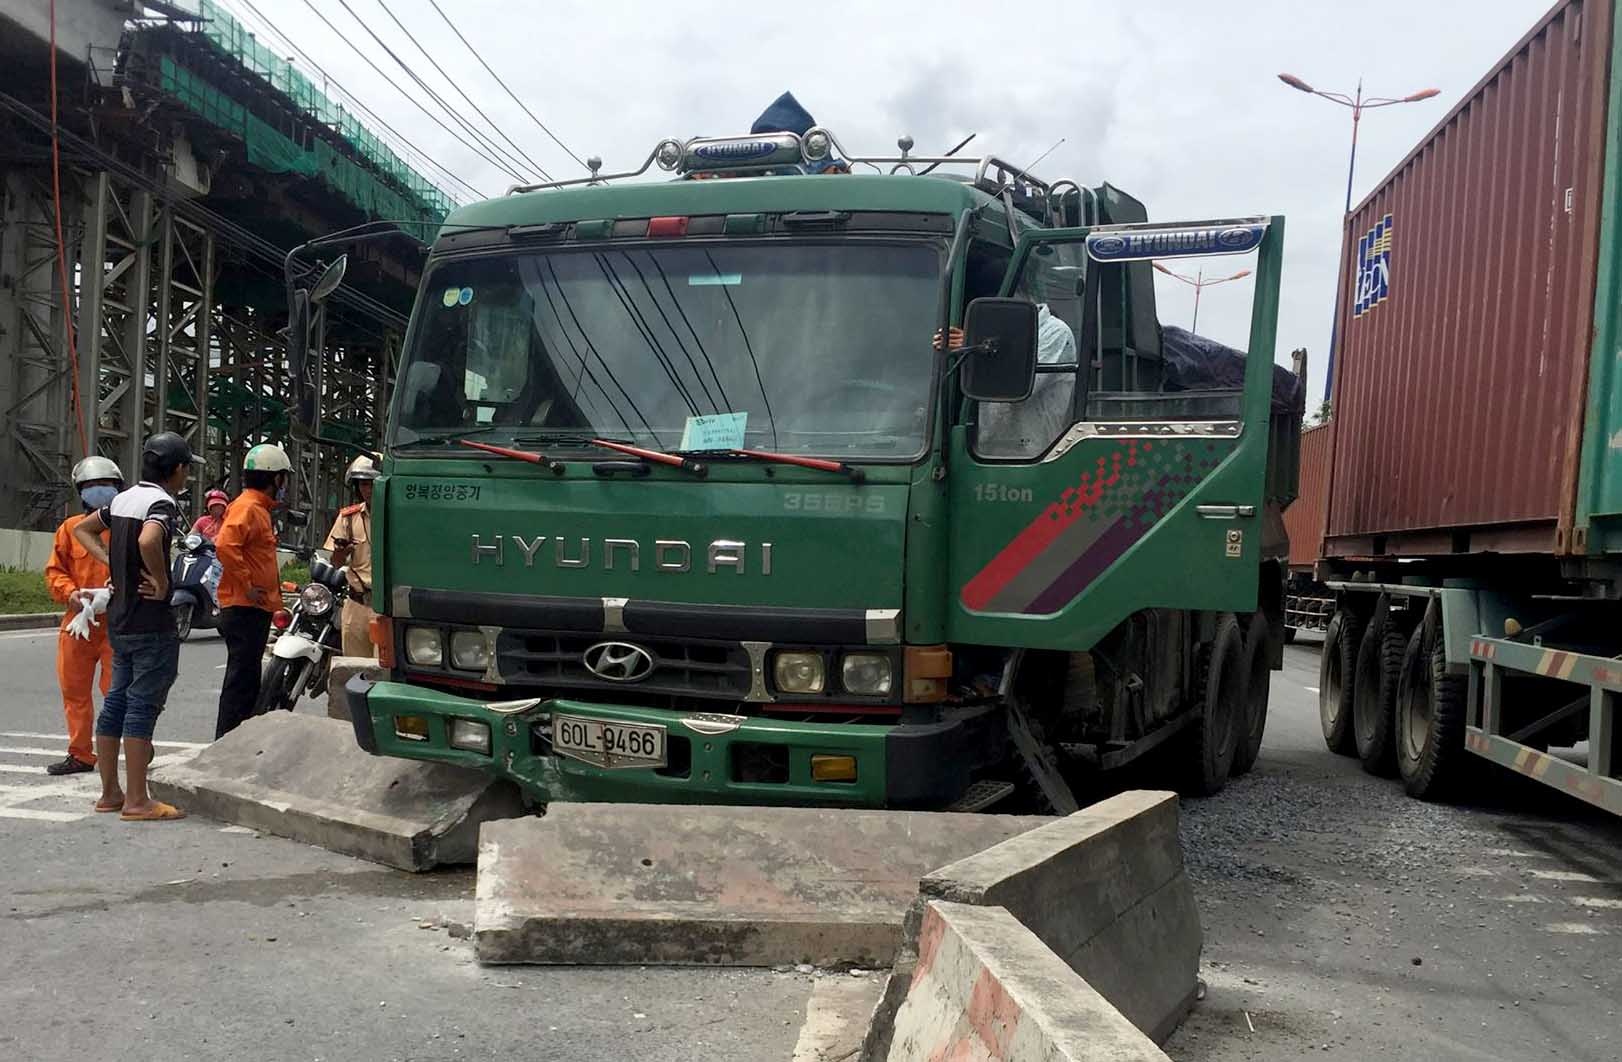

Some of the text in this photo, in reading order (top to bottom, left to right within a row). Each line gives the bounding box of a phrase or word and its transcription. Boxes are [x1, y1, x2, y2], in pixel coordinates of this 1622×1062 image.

[706, 143, 766, 155] HYUNDAI
[1129, 230, 1217, 252] HYUNDAI
[471, 533, 774, 576] HYUNDAI
[561, 721, 656, 756] 60L-9466
